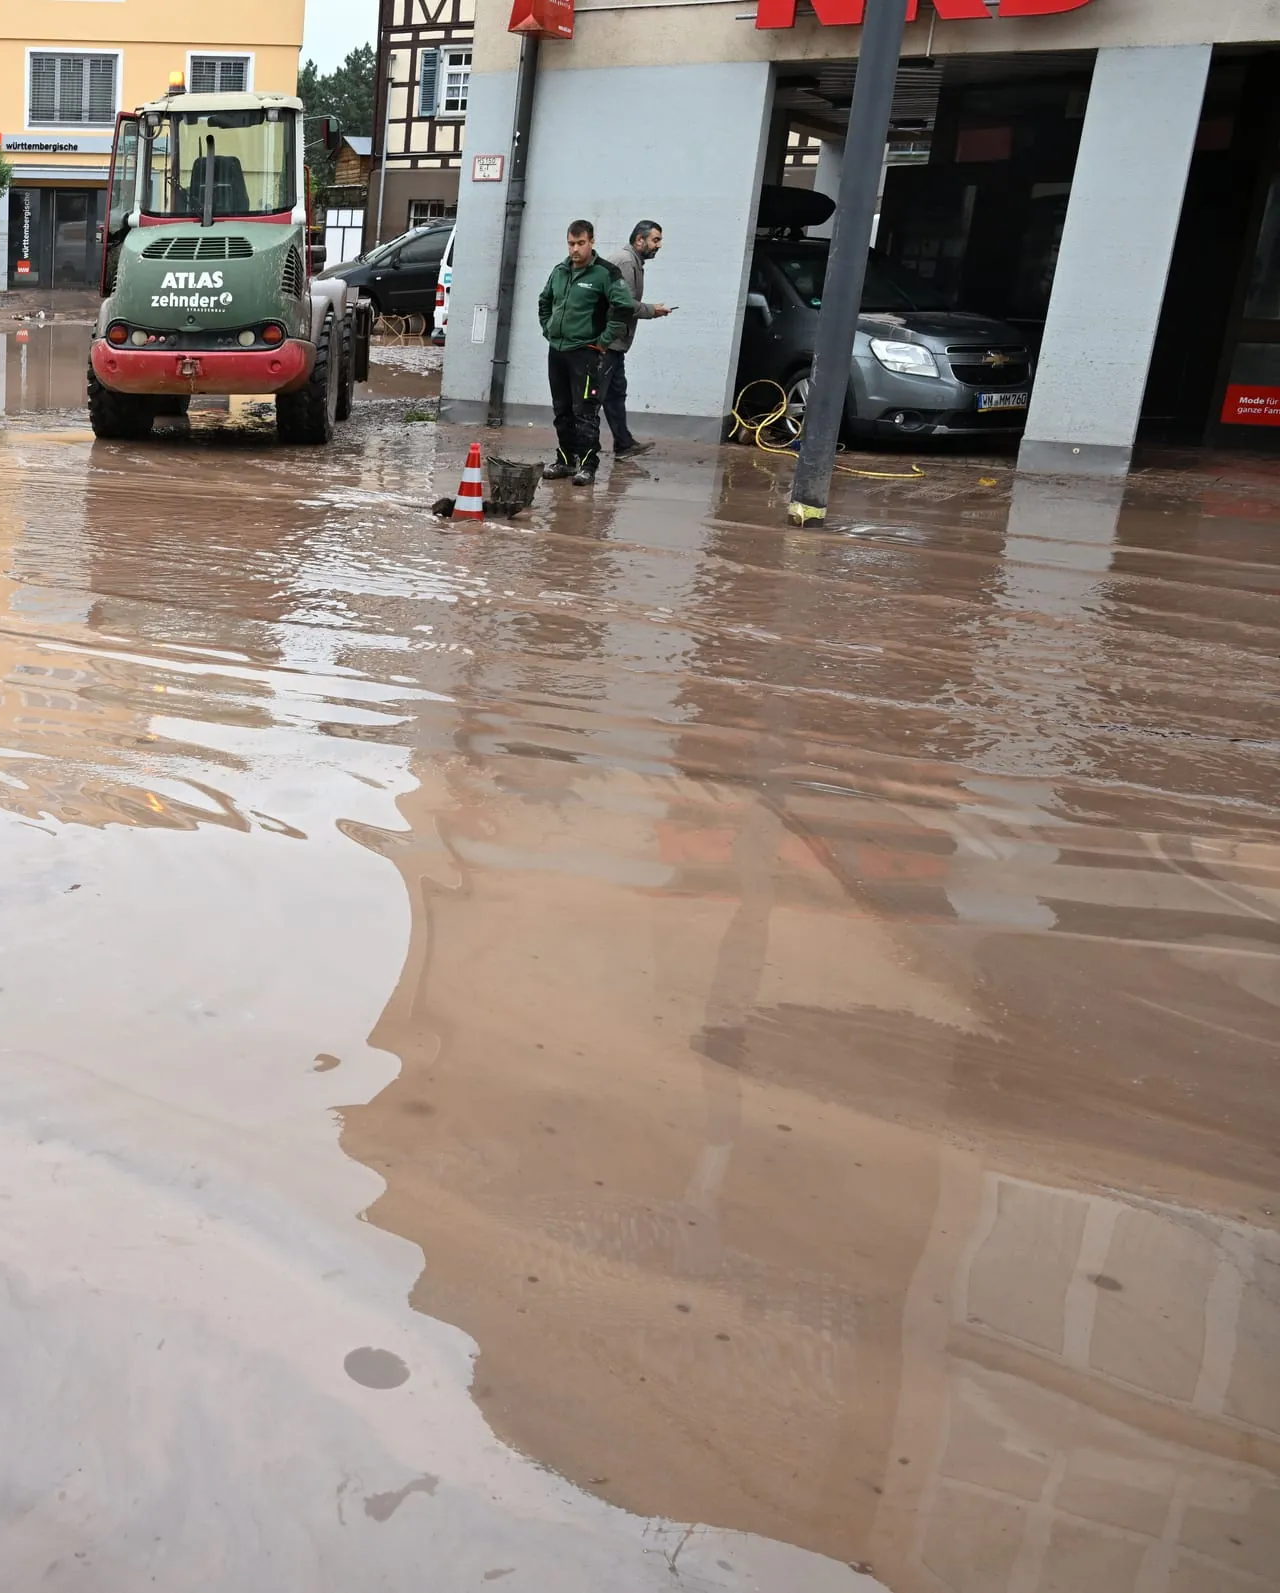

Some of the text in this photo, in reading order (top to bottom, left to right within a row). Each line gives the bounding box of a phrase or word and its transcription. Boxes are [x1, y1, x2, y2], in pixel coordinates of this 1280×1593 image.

[6, 141, 78, 152] württembergische
[22, 191, 31, 259] württembergische
[160, 271, 224, 288] ATLAS
[151, 292, 218, 307] zehnder
